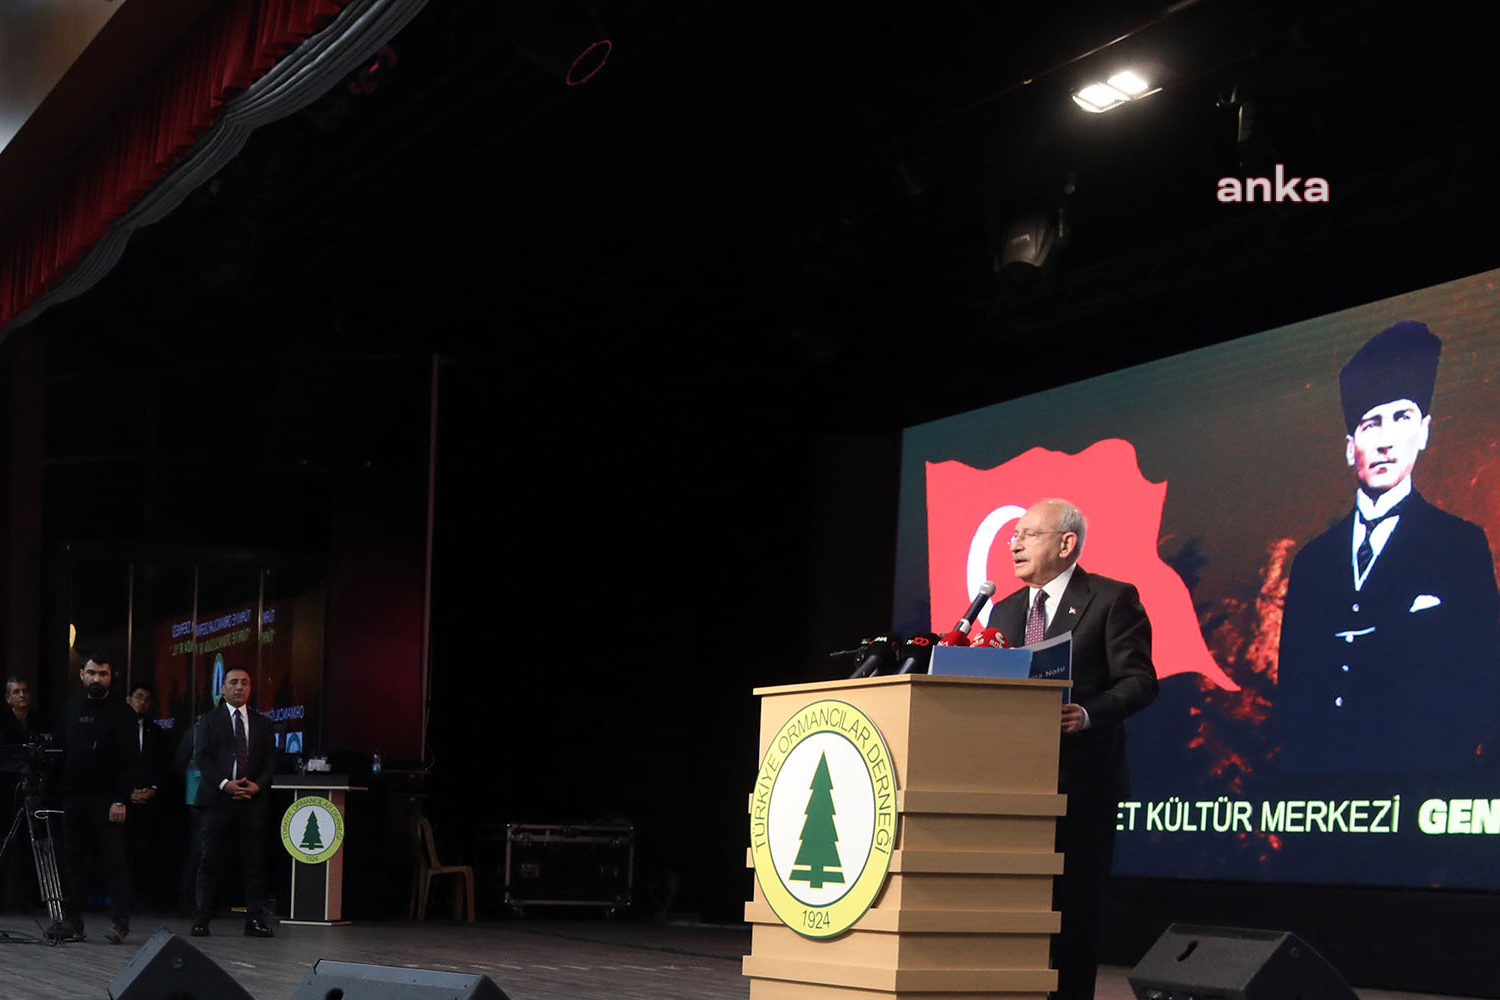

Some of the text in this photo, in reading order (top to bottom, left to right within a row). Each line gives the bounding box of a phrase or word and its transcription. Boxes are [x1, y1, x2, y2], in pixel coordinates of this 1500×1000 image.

[752, 707, 892, 855] TÜRKİYE ORMANCILAR DERNEĞİ
[1146, 796, 1253, 832] KÜLTÜR
[1260, 794, 1401, 833] MERKEZİ
[1417, 798, 1500, 835] GEN
[802, 909, 831, 929] 1924
